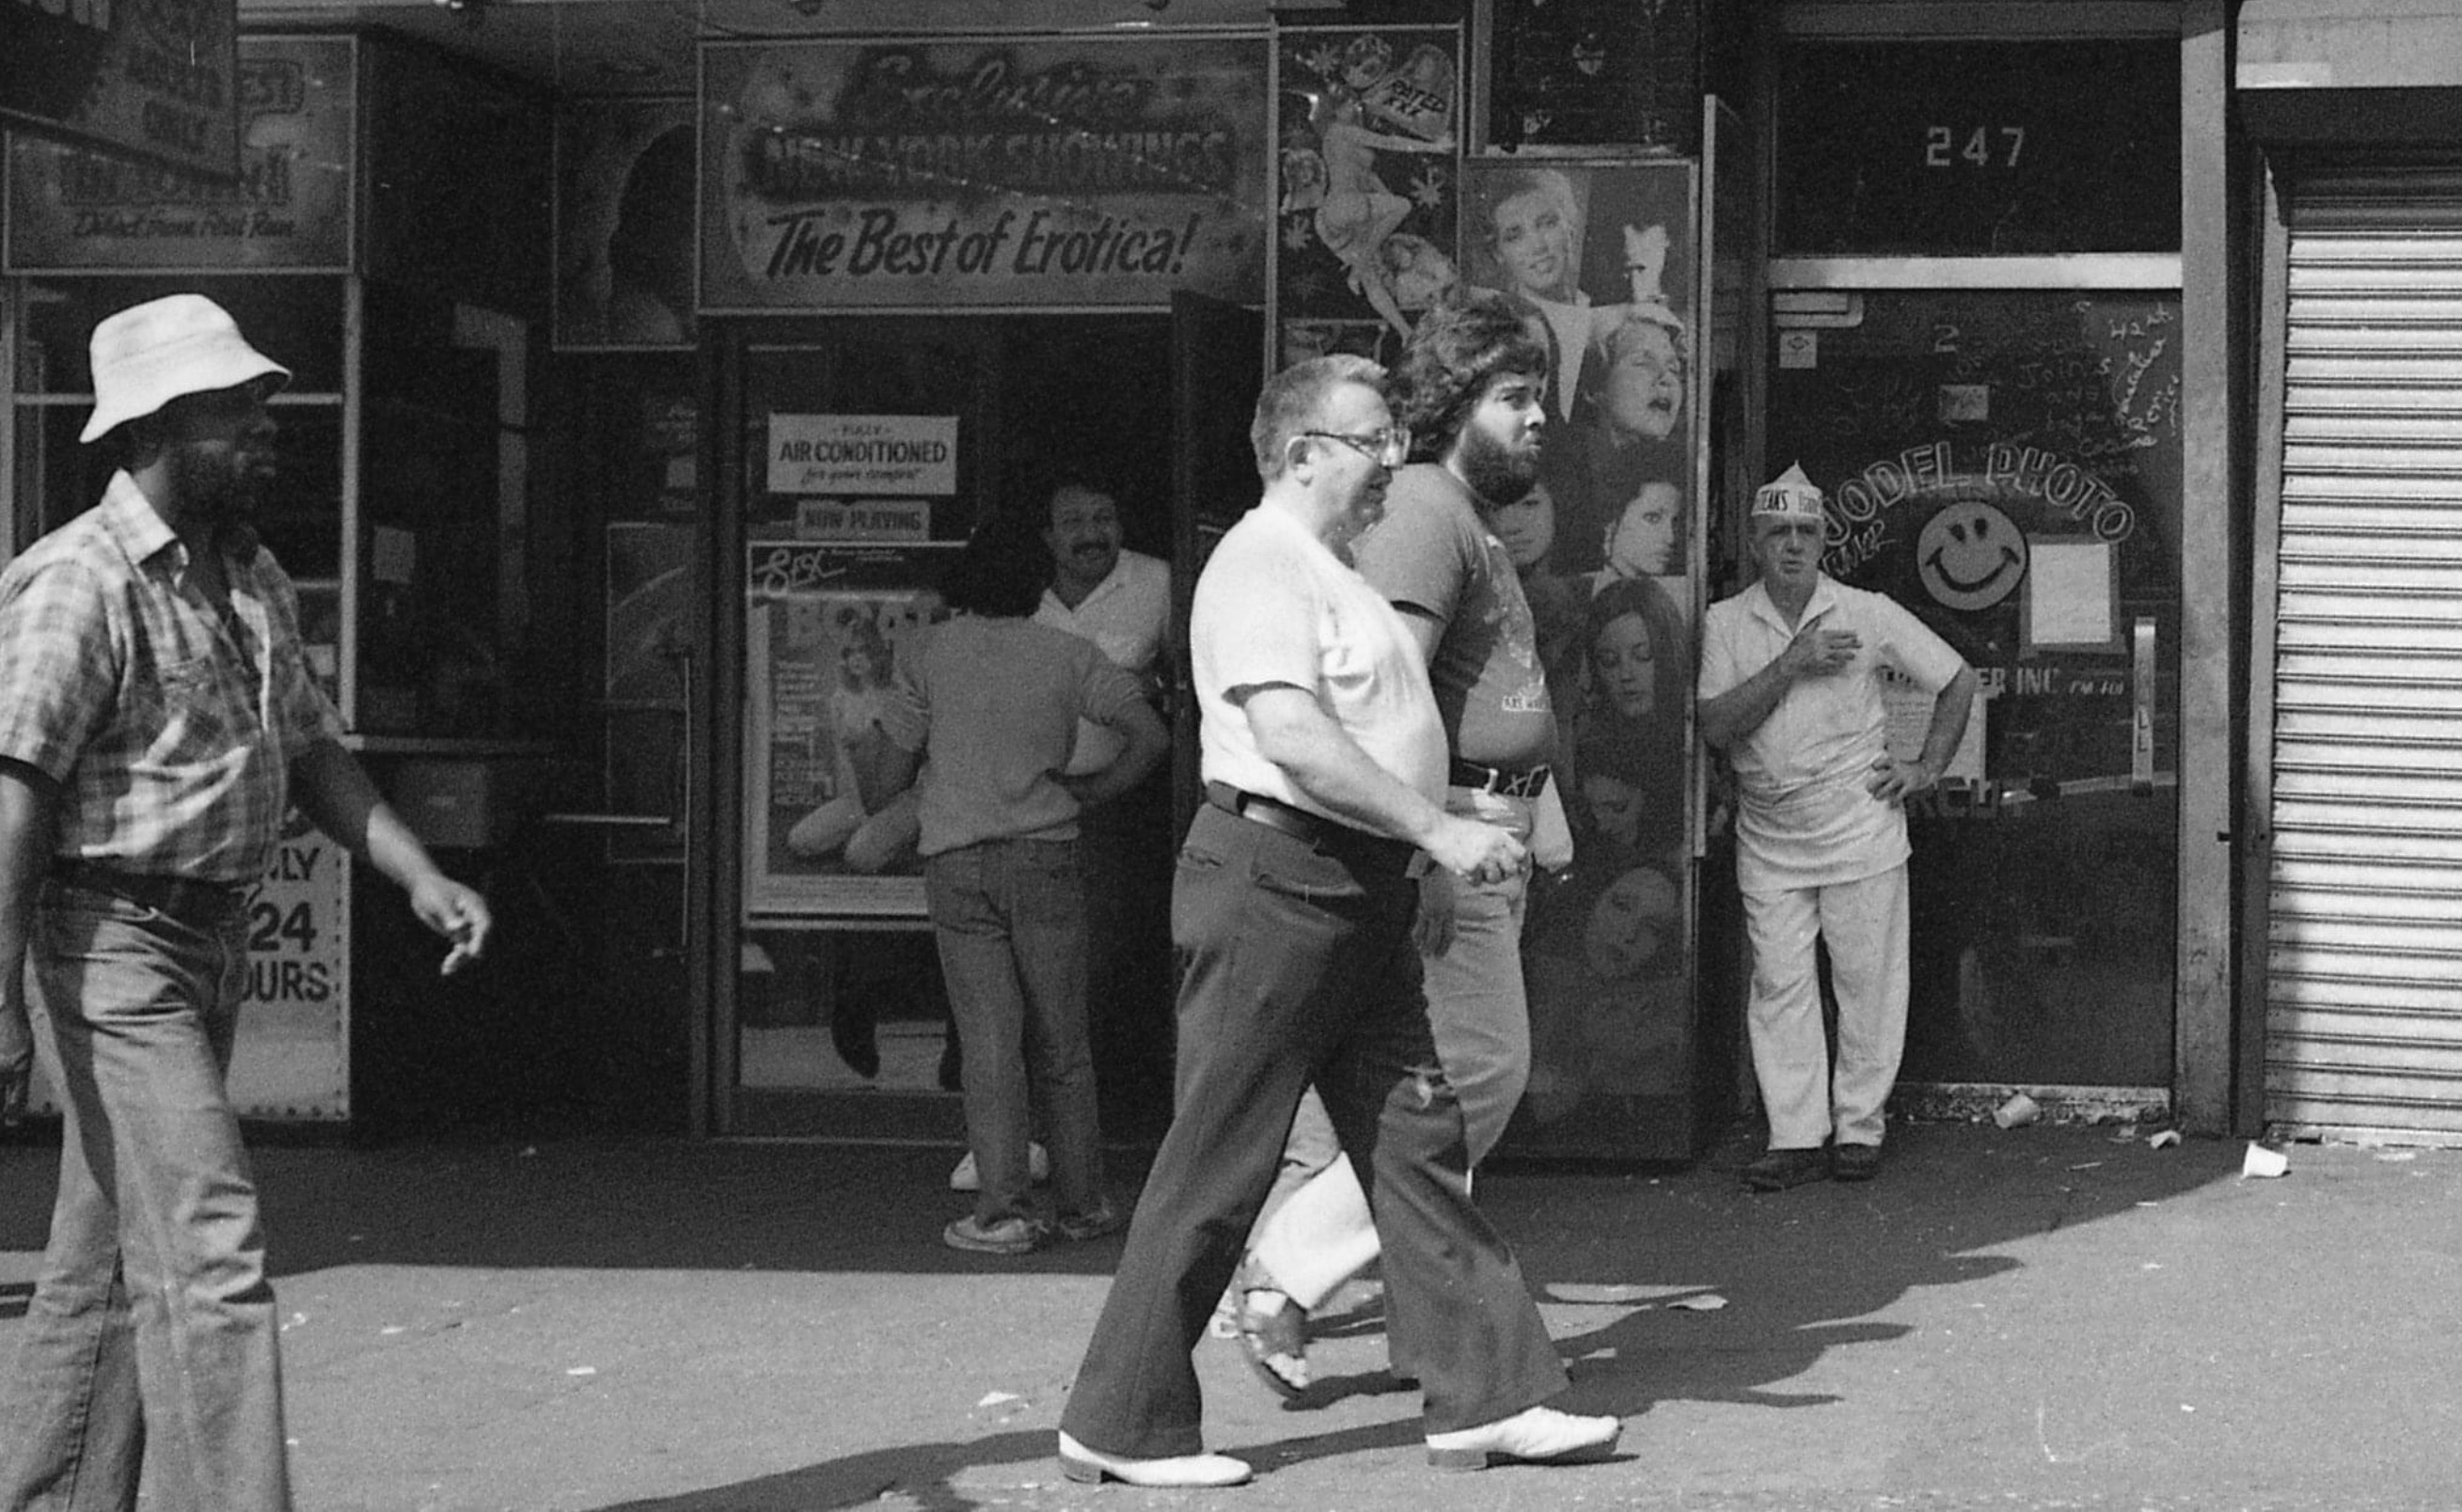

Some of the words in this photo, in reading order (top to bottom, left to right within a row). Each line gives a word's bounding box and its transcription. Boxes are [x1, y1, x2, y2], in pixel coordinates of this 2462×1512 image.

[1925, 125, 2027, 167] 247
[767, 209, 845, 279] The
[847, 208, 956, 276] Best
[956, 209, 1016, 276] of
[1012, 207, 1203, 276] Erotica!
[1933, 323, 1961, 354] 2
[779, 440, 812, 463] AIR
[815, 440, 947, 464] CONDITIONED
[1984, 441, 2135, 544] PHOTO
[850, 511, 922, 530] PLAYING
[248, 901, 318, 953] 24
